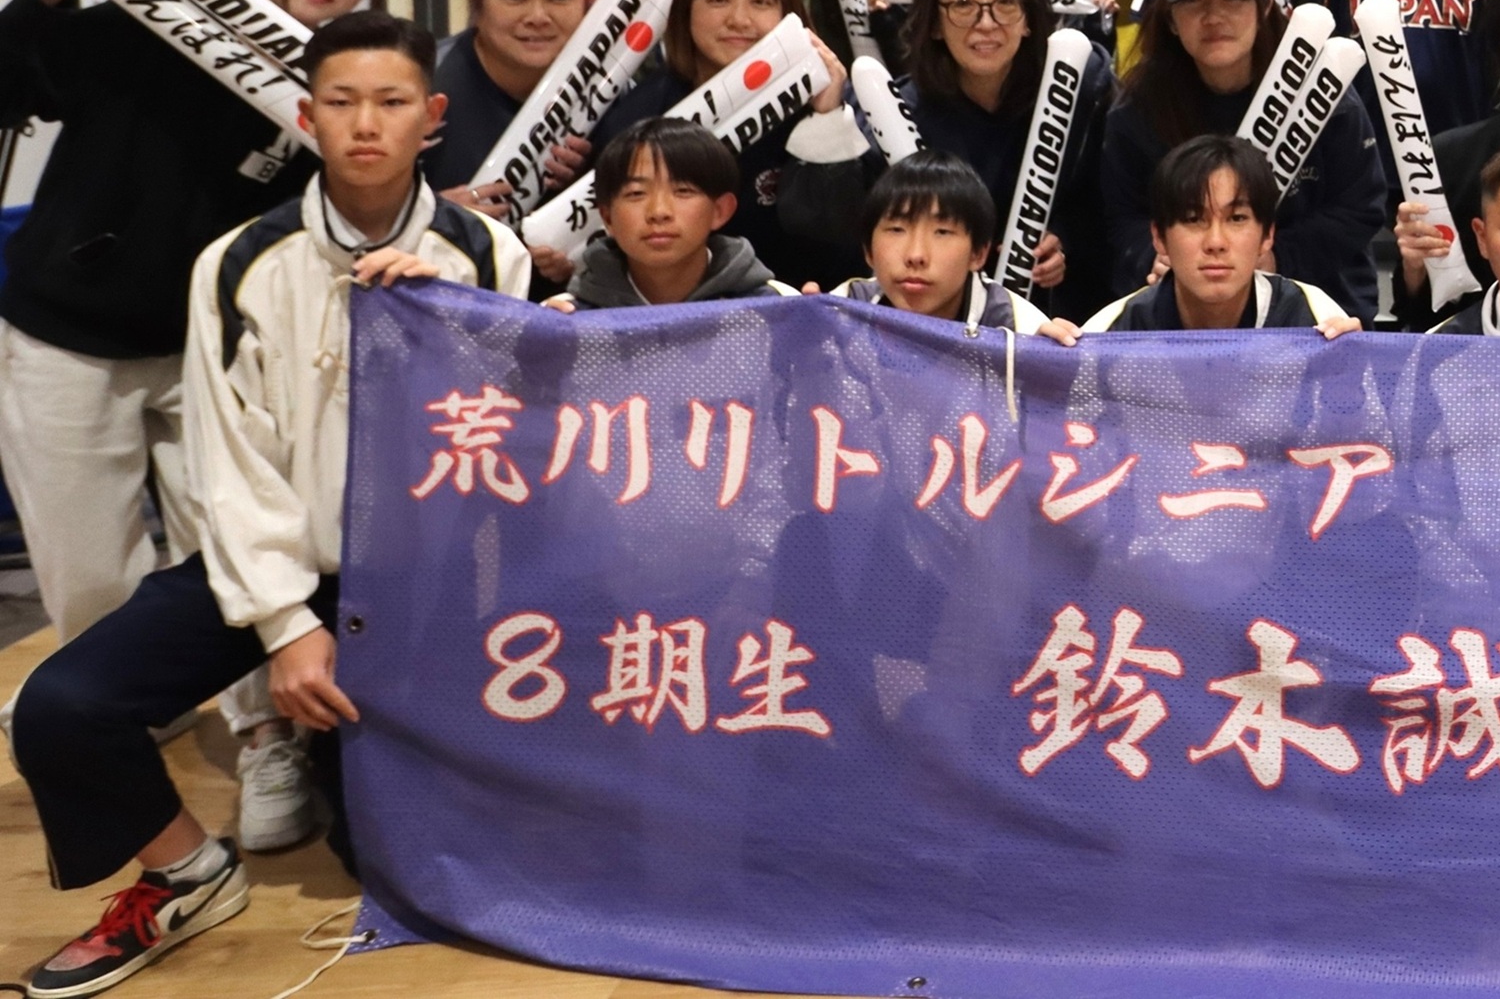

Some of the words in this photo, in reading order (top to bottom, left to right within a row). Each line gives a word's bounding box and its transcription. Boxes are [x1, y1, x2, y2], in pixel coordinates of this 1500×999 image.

[1372, 34, 1445, 196] がんばれ!
[410, 384, 1394, 540] 荒川リトルシニア
[482, 611, 833, 738] 8期生
